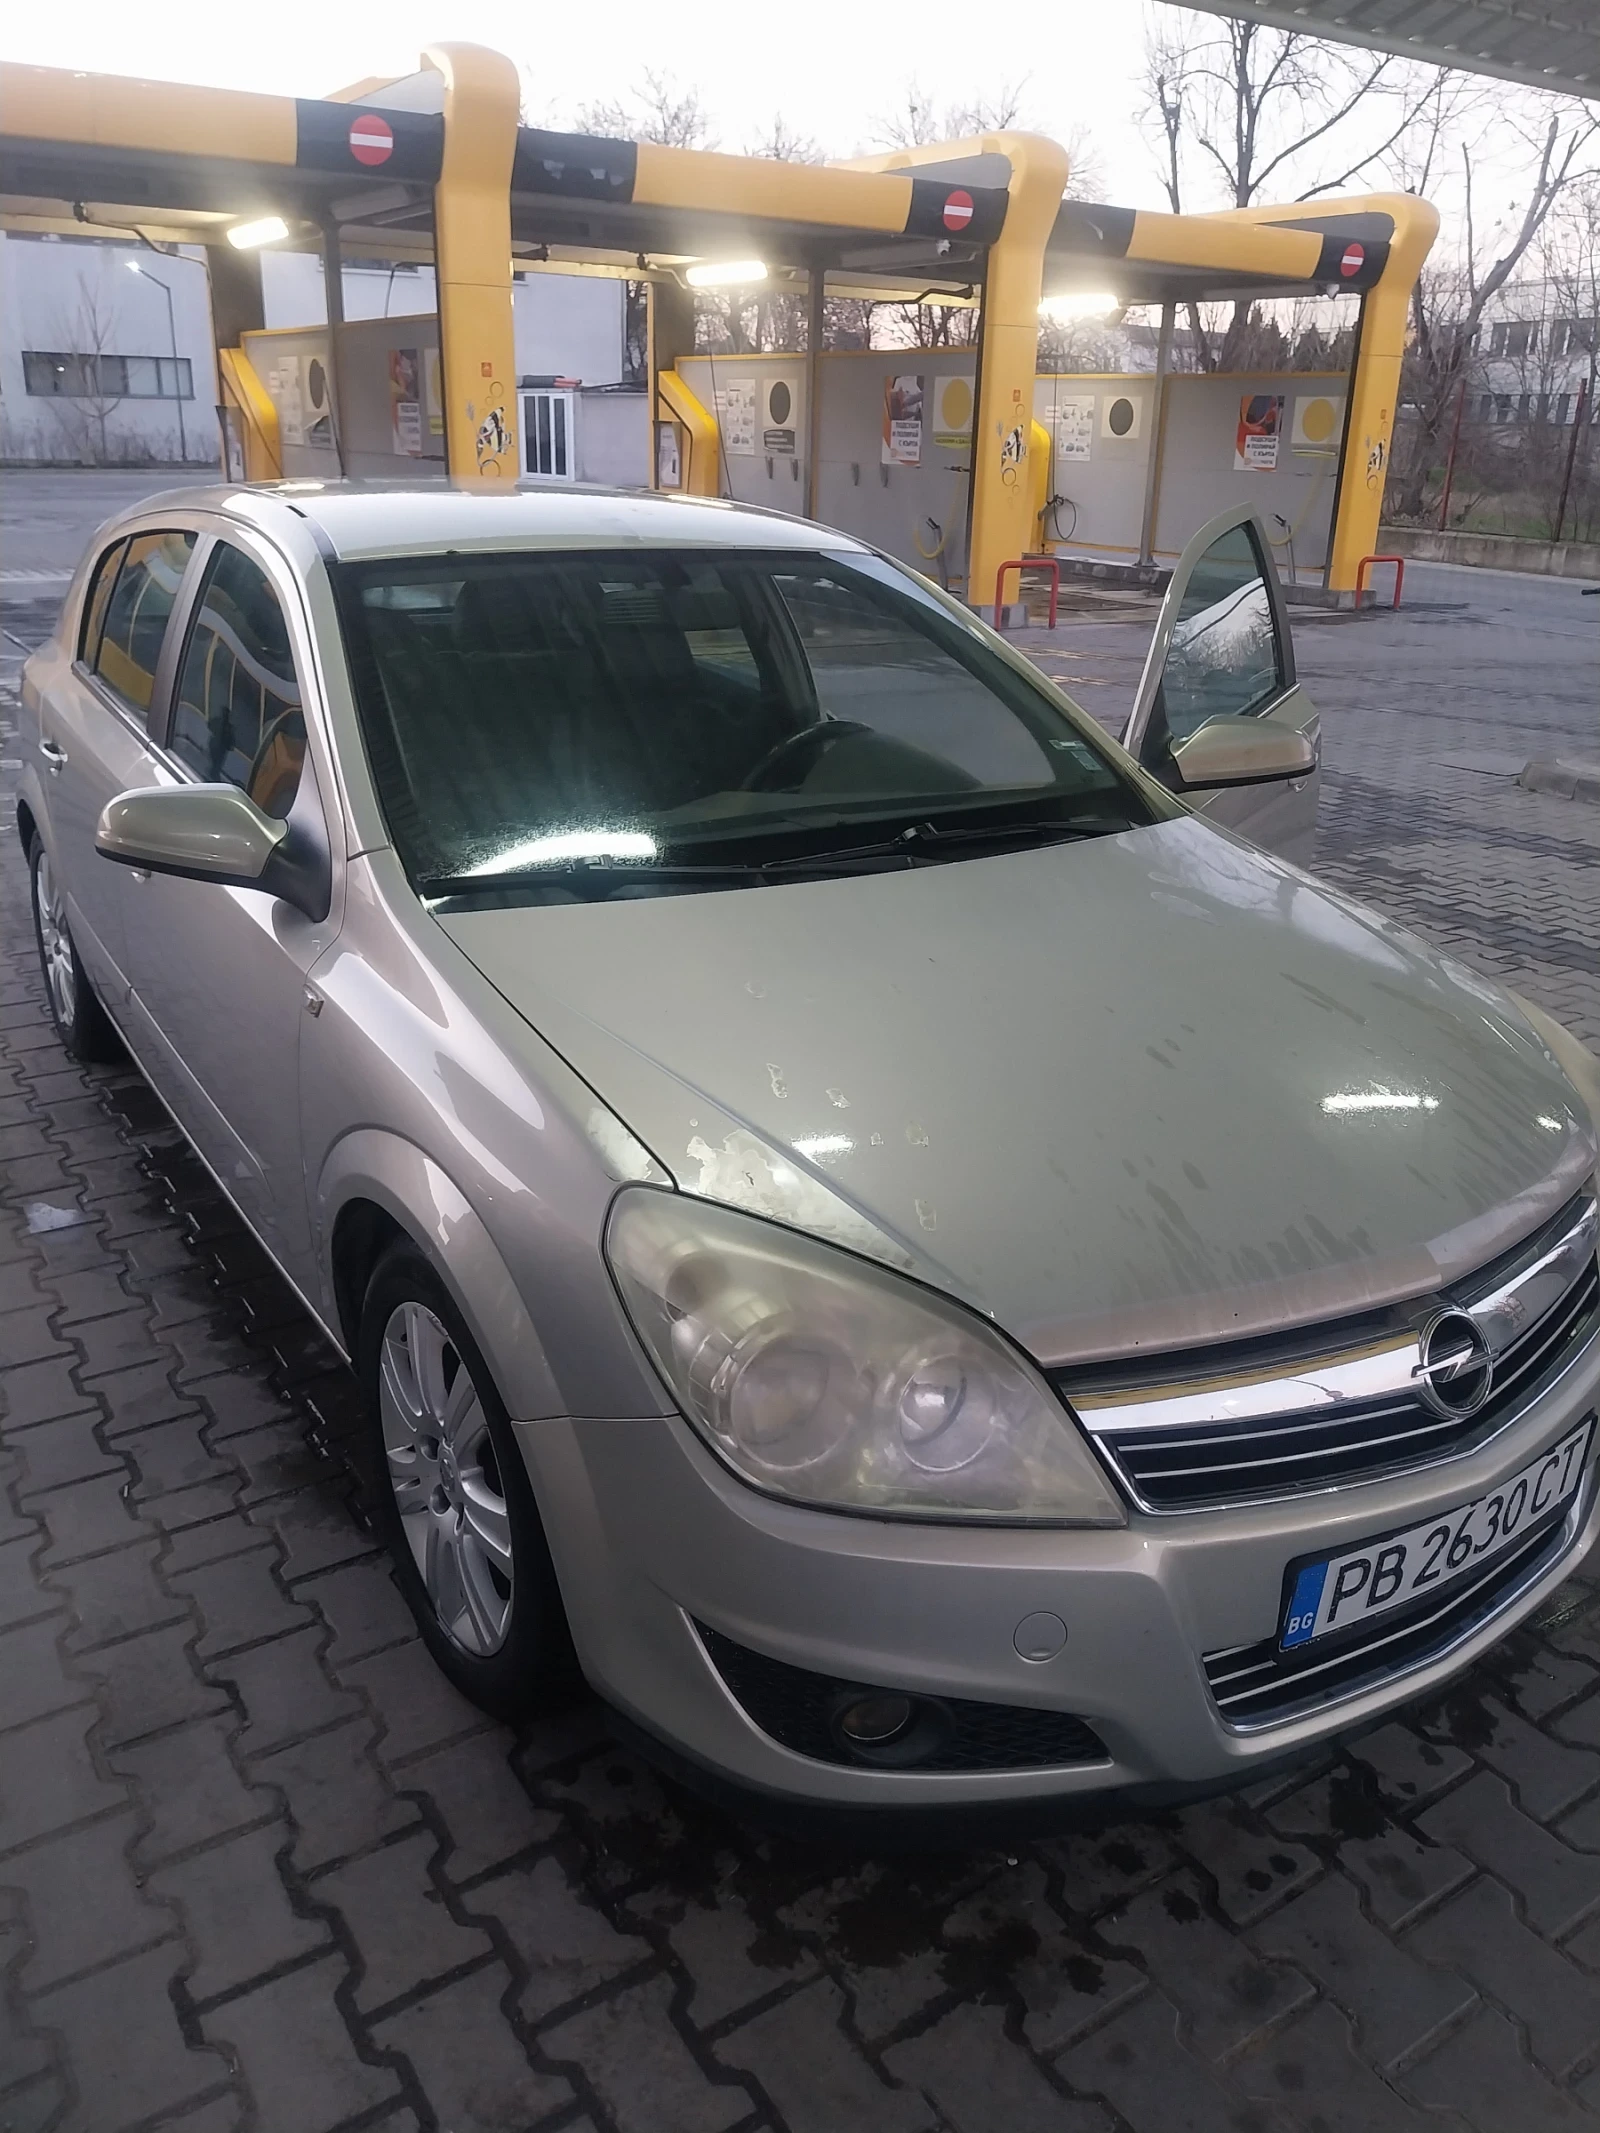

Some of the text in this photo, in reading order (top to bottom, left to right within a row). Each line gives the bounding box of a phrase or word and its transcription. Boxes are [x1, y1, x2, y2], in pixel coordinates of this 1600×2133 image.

[1327, 1434, 1584, 1623] PB 2630 CT
[1288, 1612, 1314, 1635] BG
